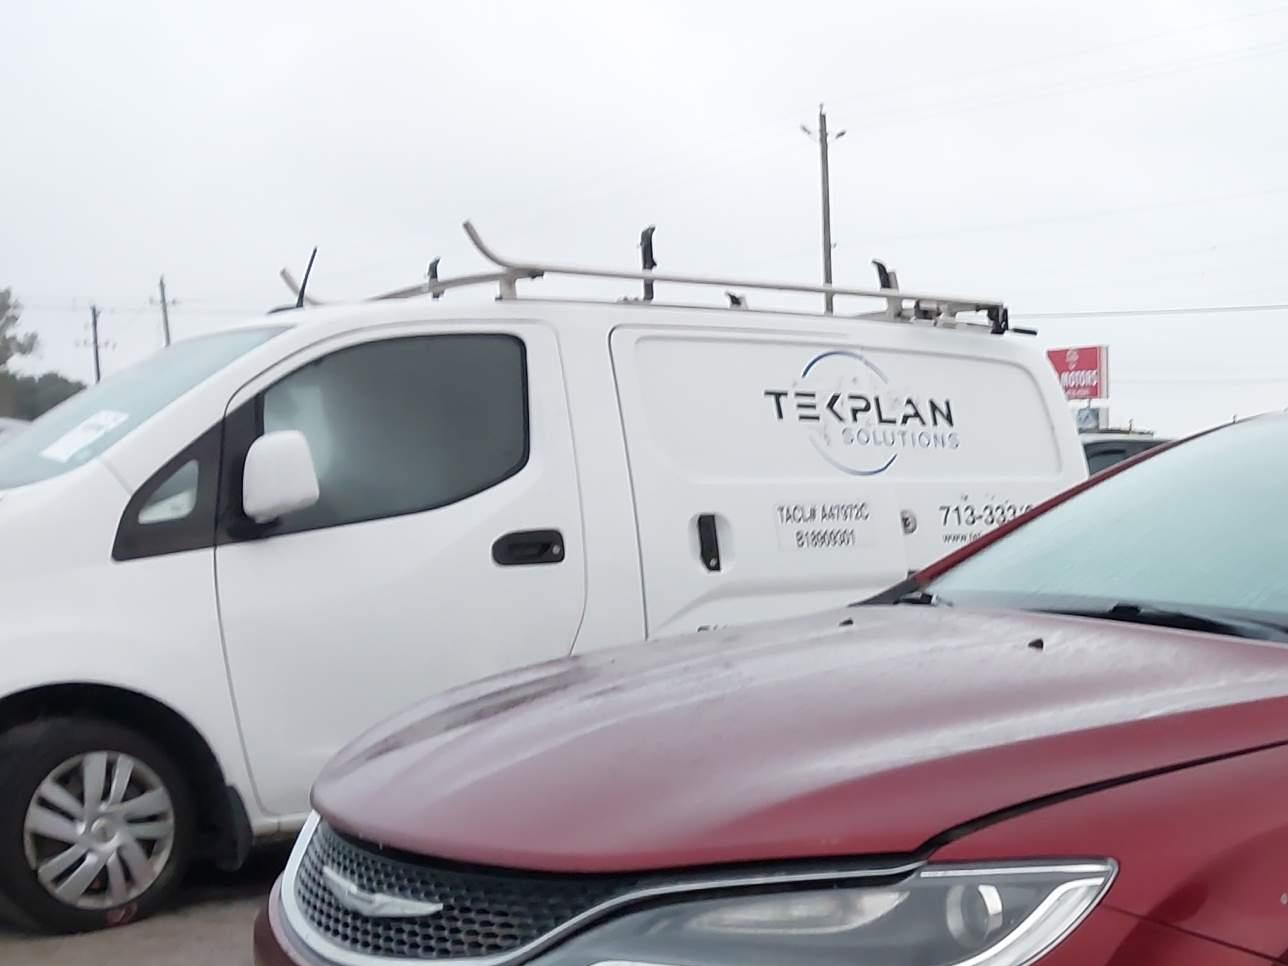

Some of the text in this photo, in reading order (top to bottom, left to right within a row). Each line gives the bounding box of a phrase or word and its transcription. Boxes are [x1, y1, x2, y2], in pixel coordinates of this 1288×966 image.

[1060, 369, 1098, 387] MOTORS
[763, 390, 954, 427] TEKPLAN
[841, 427, 961, 449] SOLUTIONS
